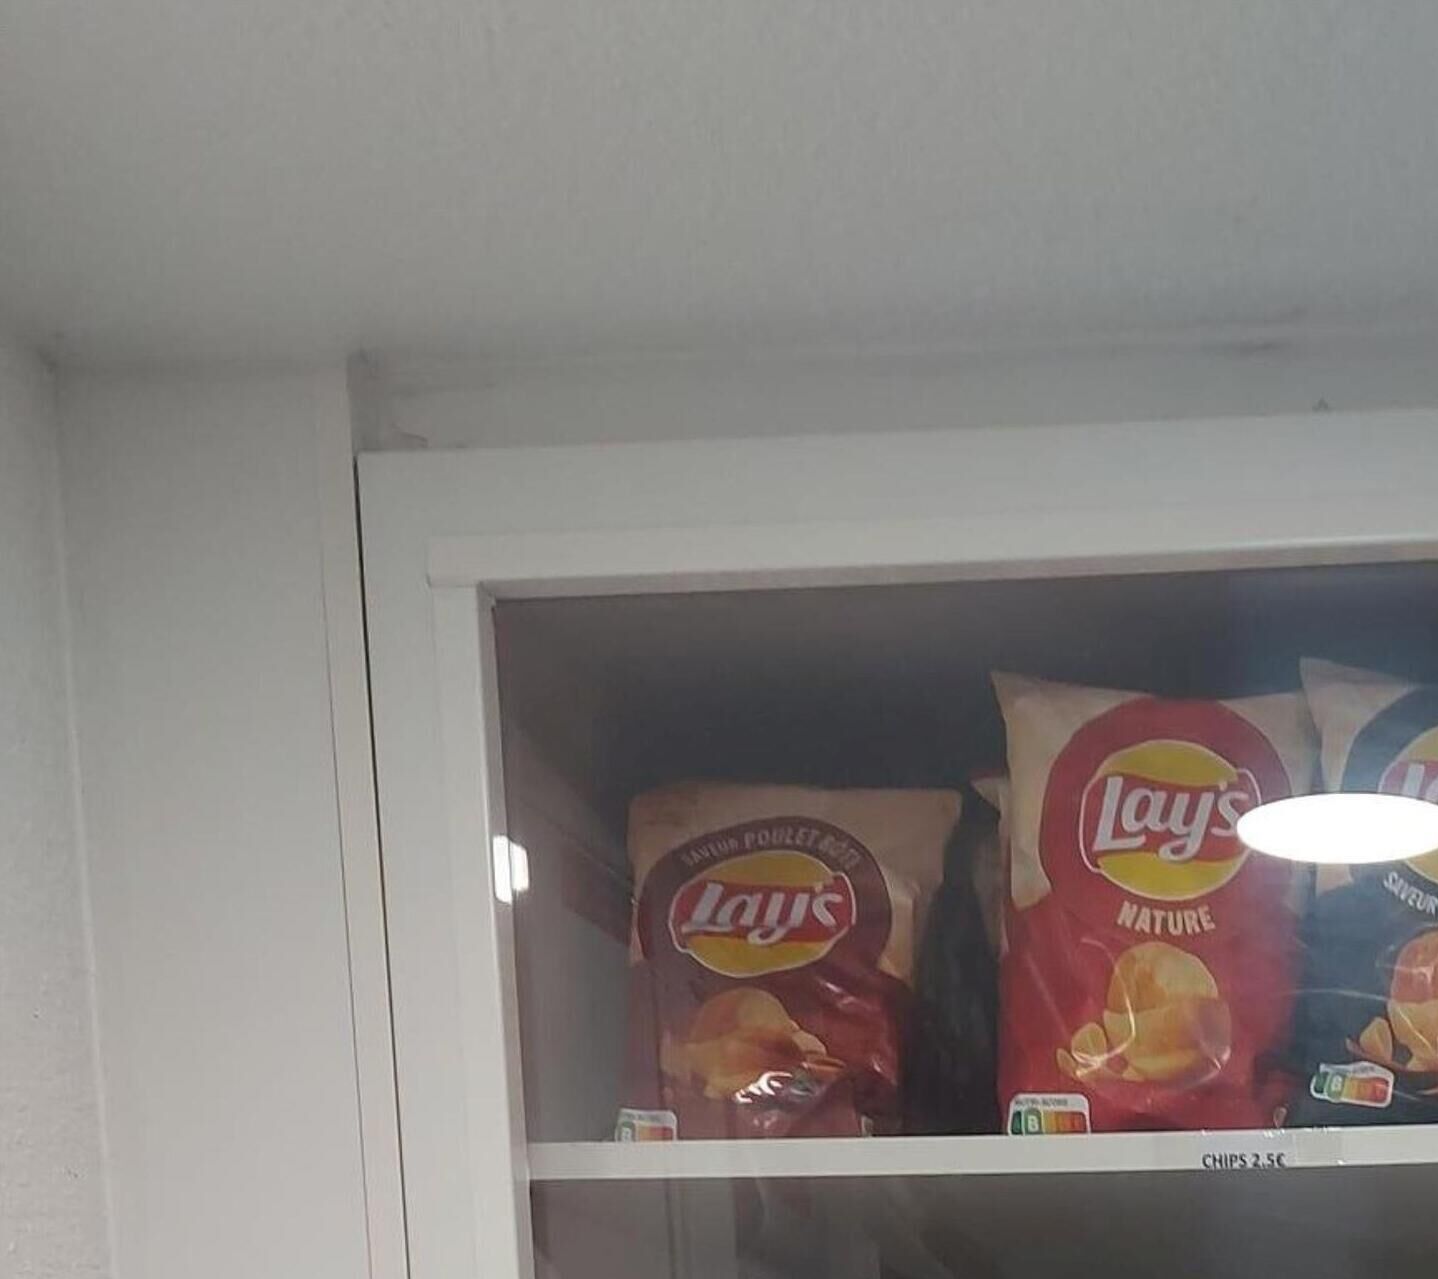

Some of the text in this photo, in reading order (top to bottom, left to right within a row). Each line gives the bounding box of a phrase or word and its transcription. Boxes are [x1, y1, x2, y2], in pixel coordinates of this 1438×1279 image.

[1093, 775, 1250, 862] Lay's
[1383, 871, 1438, 914] SAVEUR
[1117, 900, 1216, 937] NATURE
[1202, 1153, 1247, 1169] CHIPS
